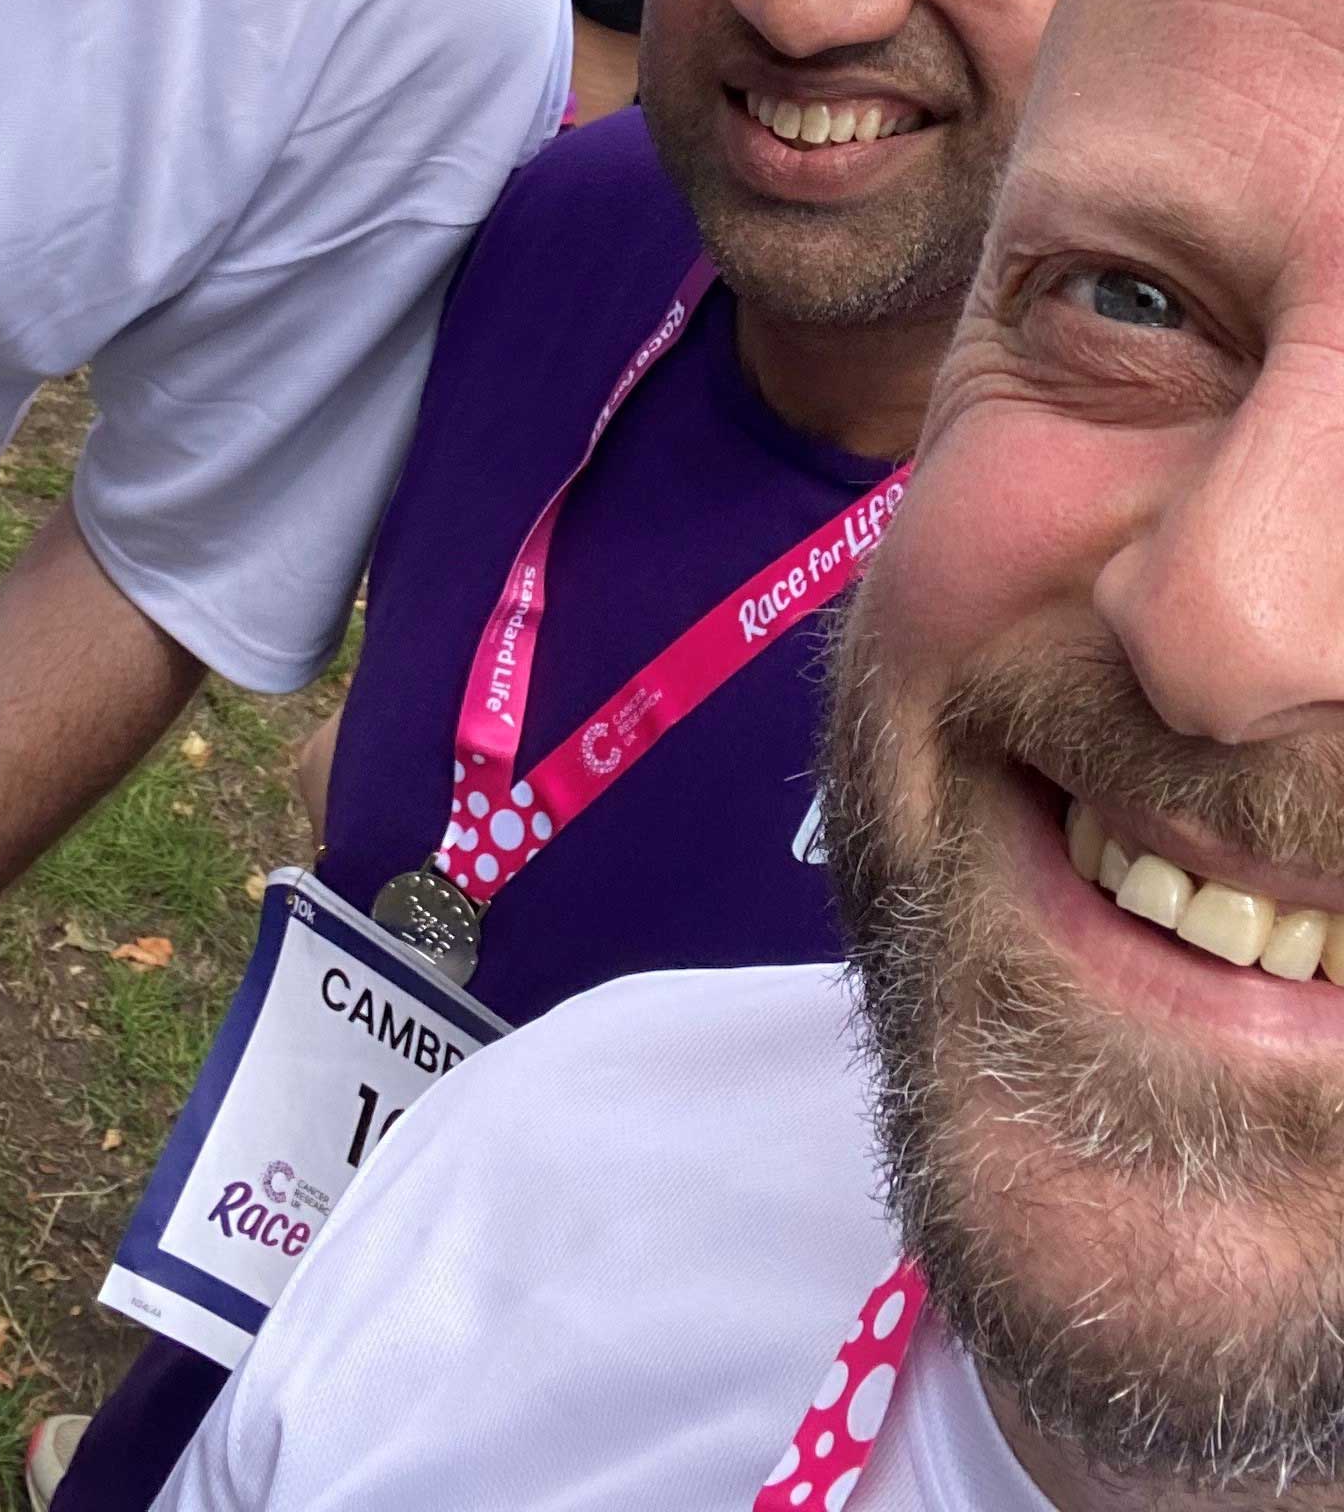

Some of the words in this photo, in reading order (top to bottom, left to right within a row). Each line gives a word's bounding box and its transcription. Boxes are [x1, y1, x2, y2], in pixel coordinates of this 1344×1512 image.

[636, 300, 685, 368] Race
[738, 566, 808, 643] Race
[808, 539, 845, 583] for
[844, 483, 904, 558] Life
[496, 565, 537, 666] Standard
[485, 666, 513, 713] Life
[291, 894, 317, 925] 10k
[346, 1082, 406, 1170] 1
[208, 1181, 311, 1256] Race
